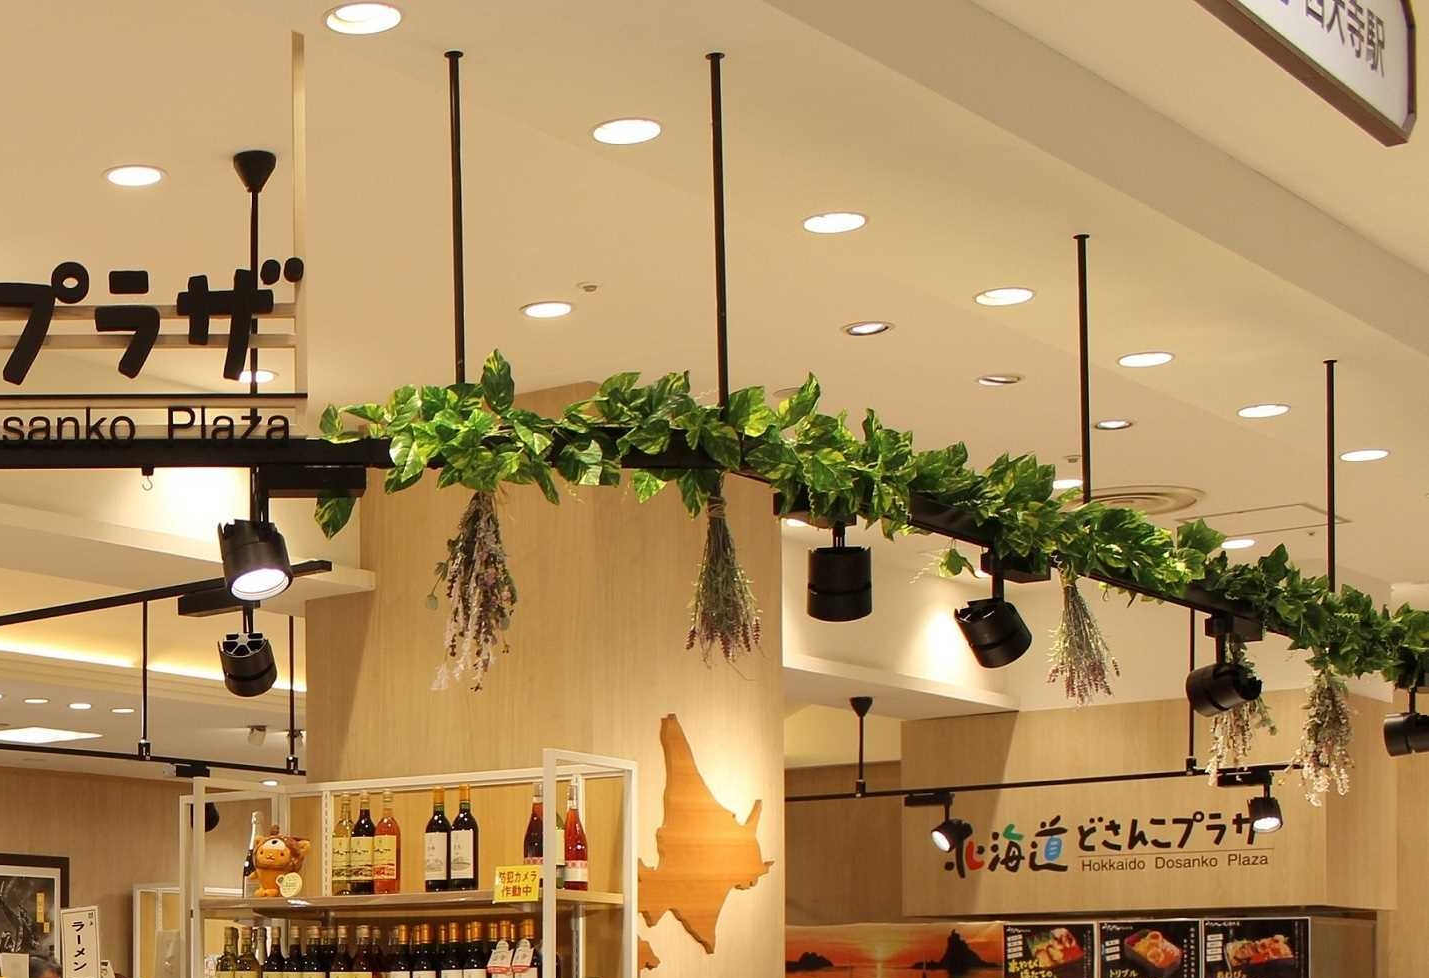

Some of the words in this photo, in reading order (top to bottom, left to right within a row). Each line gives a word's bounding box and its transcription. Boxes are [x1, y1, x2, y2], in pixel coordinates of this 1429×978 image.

[169, 406, 291, 446] Plaza
[1081, 856, 1147, 873] Hokkaido
[1154, 854, 1219, 871] Dosanko
[1227, 851, 1269, 868] Plaza
[502, 884, 532, 897] 作動中
[72, 921, 87, 972] ラーメン
